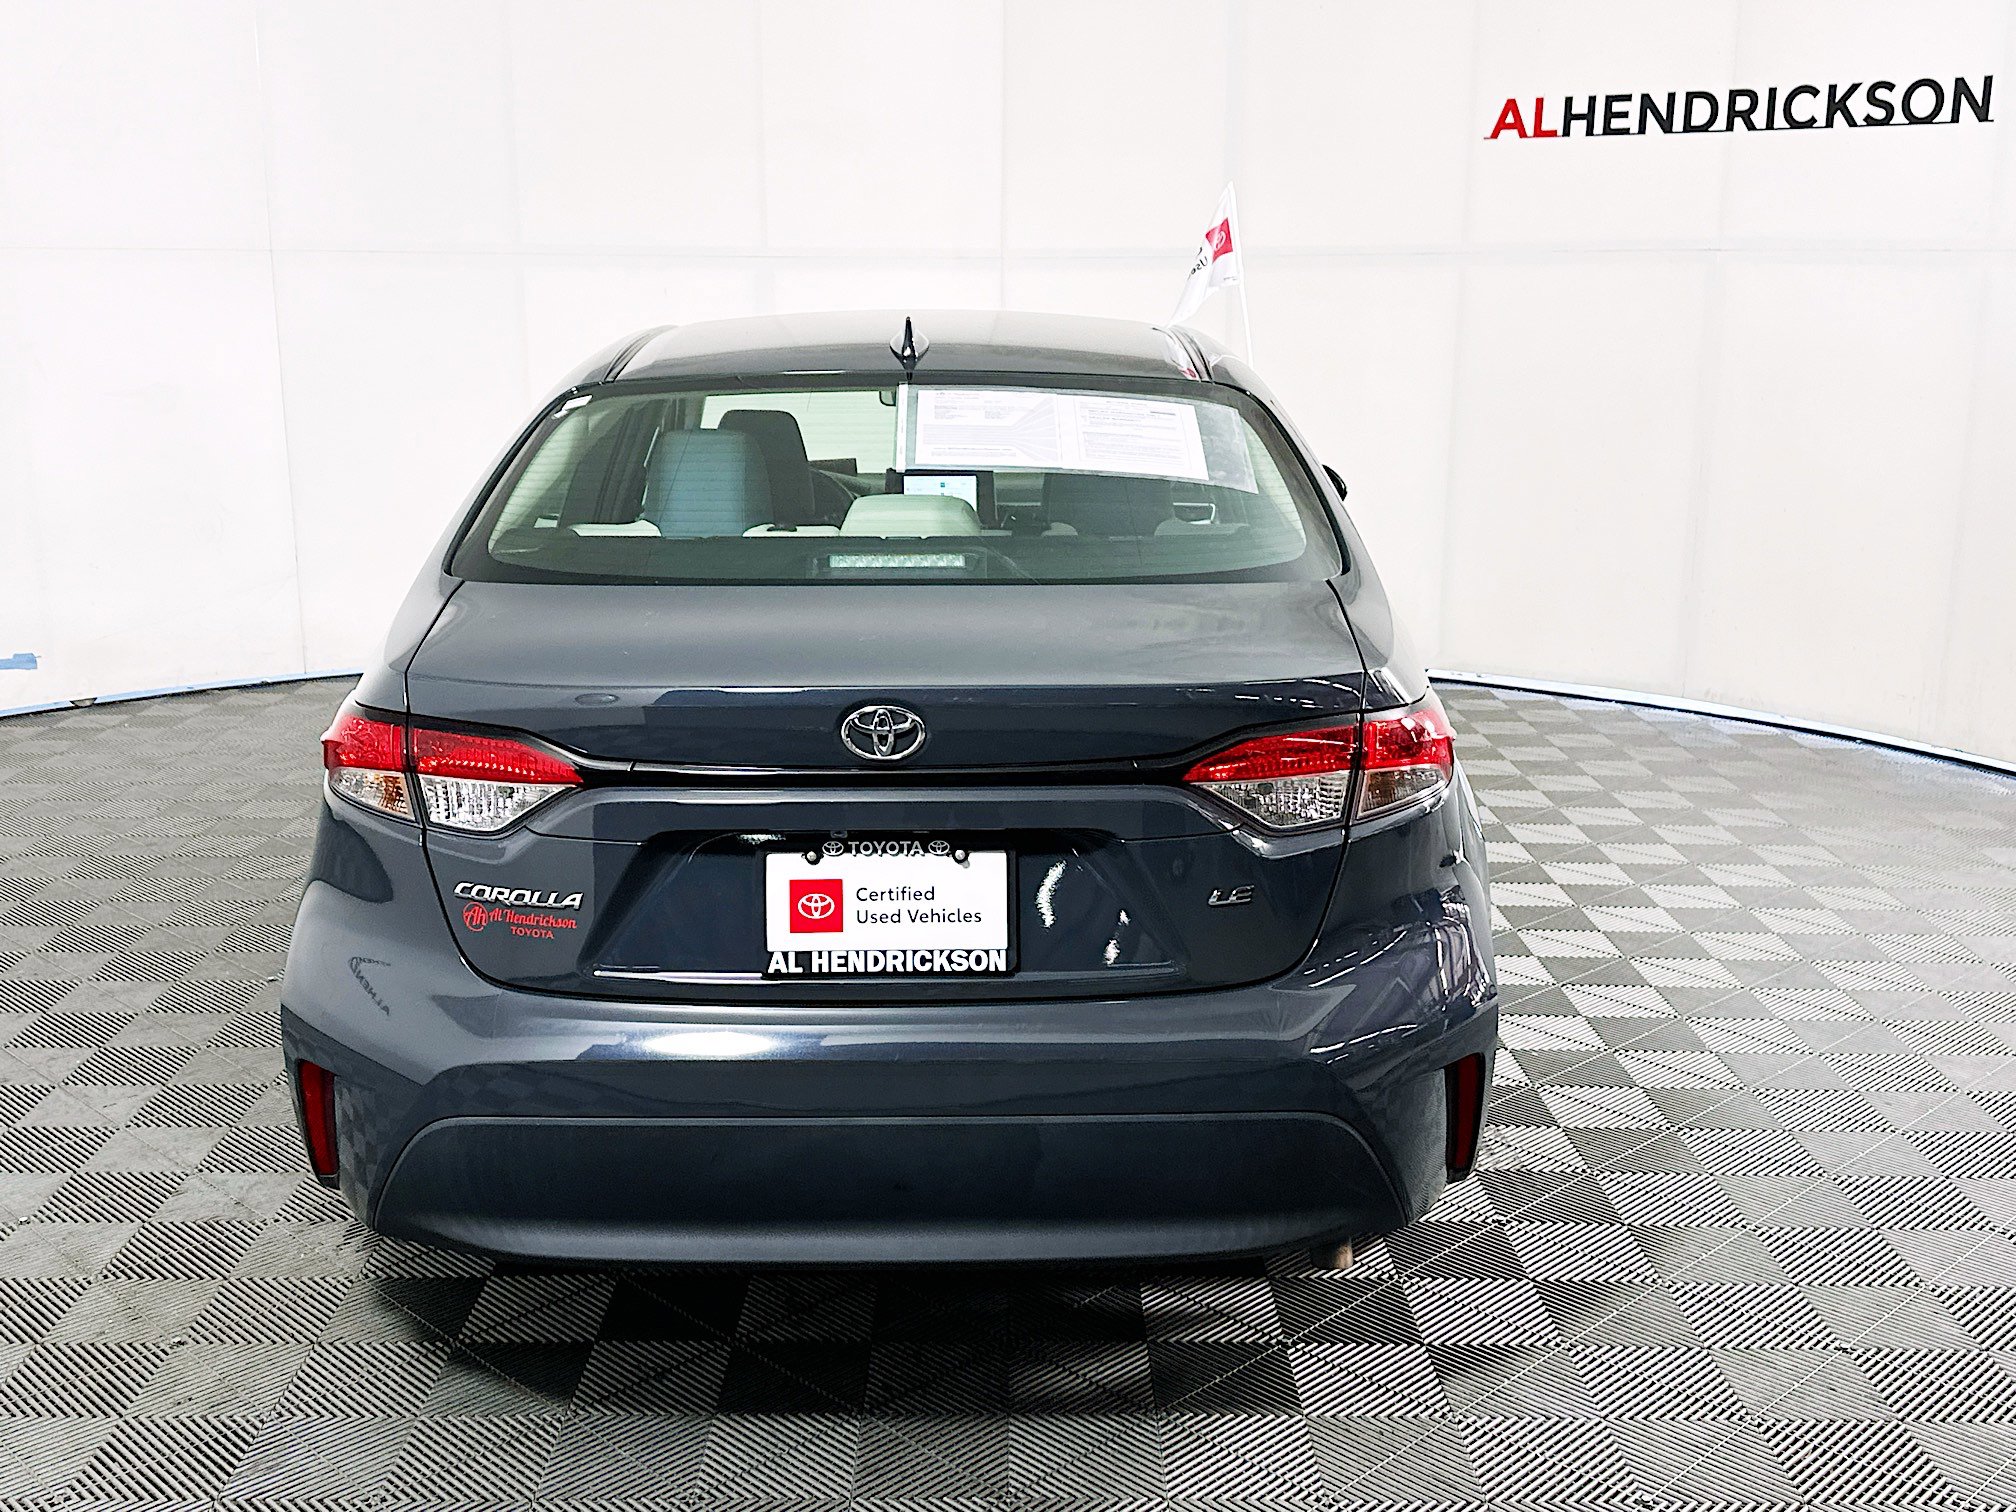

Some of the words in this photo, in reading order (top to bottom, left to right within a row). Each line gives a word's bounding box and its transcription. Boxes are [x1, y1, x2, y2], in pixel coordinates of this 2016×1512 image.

[848, 841, 925, 856] TOYOTA
[453, 881, 584, 910] COROLLA
[856, 886, 935, 902] Certified
[1208, 885, 1254, 906] LE
[503, 909, 577, 929] Hendrickson
[856, 909, 901, 924] Used
[907, 908, 982, 924] Vehicles
[511, 926, 555, 939] TOYOTA
[768, 951, 804, 973] AL
[811, 949, 1007, 973] HENDRICKSON
